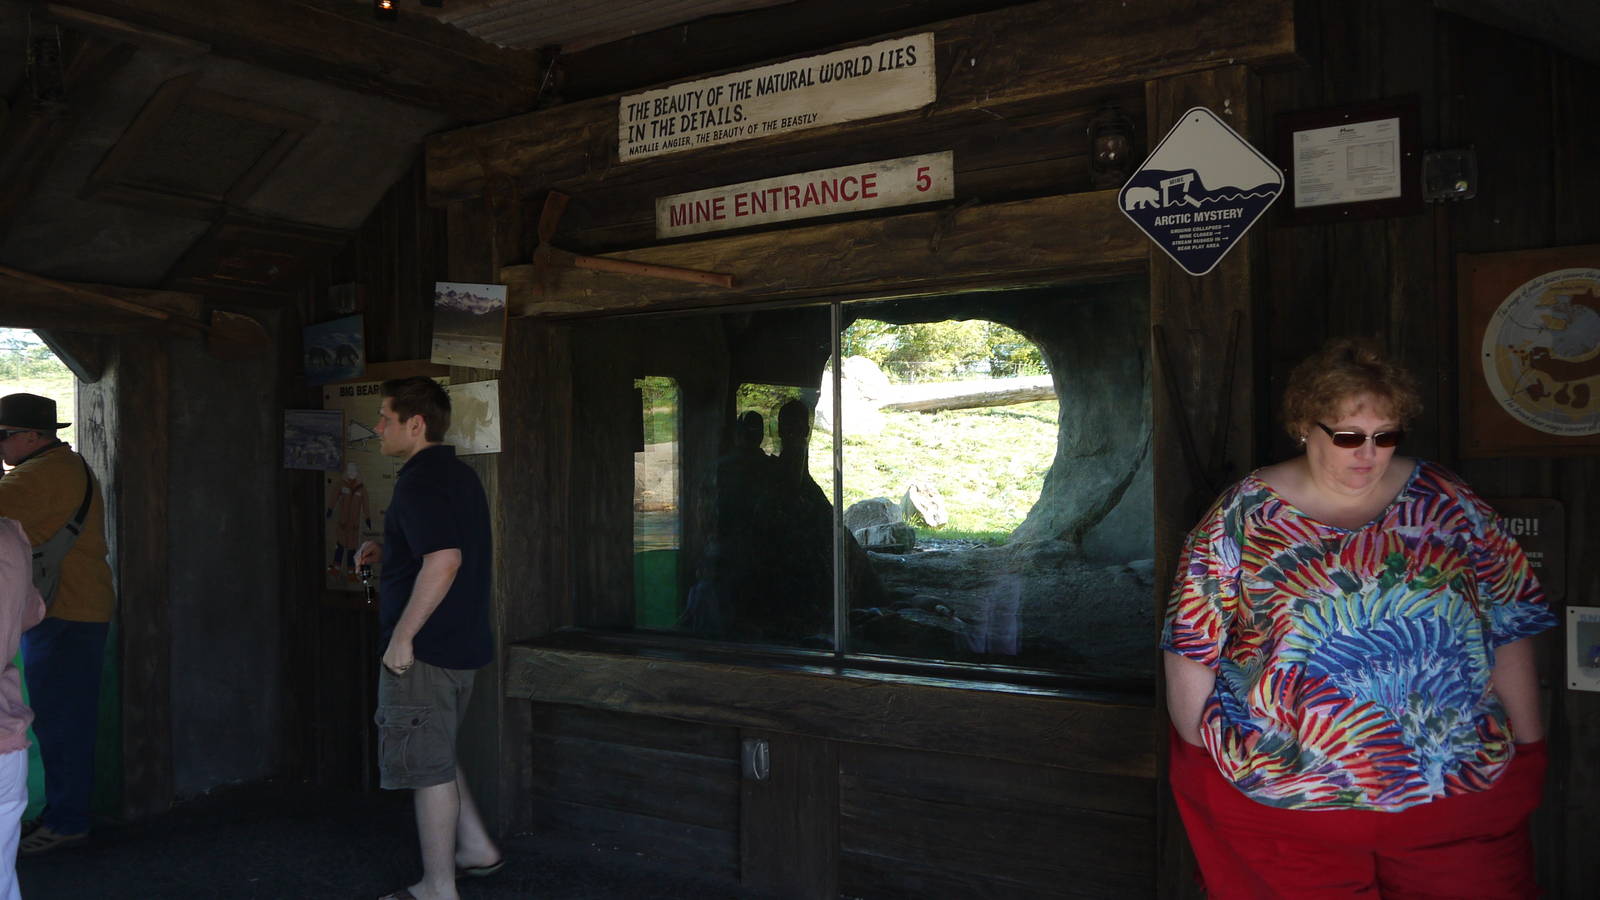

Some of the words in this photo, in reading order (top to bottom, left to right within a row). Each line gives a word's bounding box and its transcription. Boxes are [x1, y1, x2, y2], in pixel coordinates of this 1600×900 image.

[628, 101, 650, 122] THE
[654, 90, 703, 117] BEAUTY
[707, 86, 723, 107] OF
[728, 79, 753, 102] THE
[756, 67, 815, 97] NATURAL
[819, 55, 873, 83] WORLD
[878, 45, 917, 73] LIES
[628, 123, 646, 143] IN
[651, 117, 676, 139] THE
[681, 104, 747, 132] DETAILS.
[629, 142, 659, 156] NATALIE
[662, 137, 694, 150] ANGIER,
[696, 132, 710, 144] THE
[713, 126, 745, 141] BEAUTY
[747, 123, 758, 135] OF
[762, 120, 778, 132] THE
[781, 113, 818, 128] BEASTLY
[669, 197, 726, 227] MINE
[735, 173, 878, 217] ENTRANCE
[916, 166, 932, 192] 5
[1154, 213, 1191, 227] ARCTIC
[1194, 208, 1244, 223] MYSTERY
[340, 384, 354, 397] BIG
